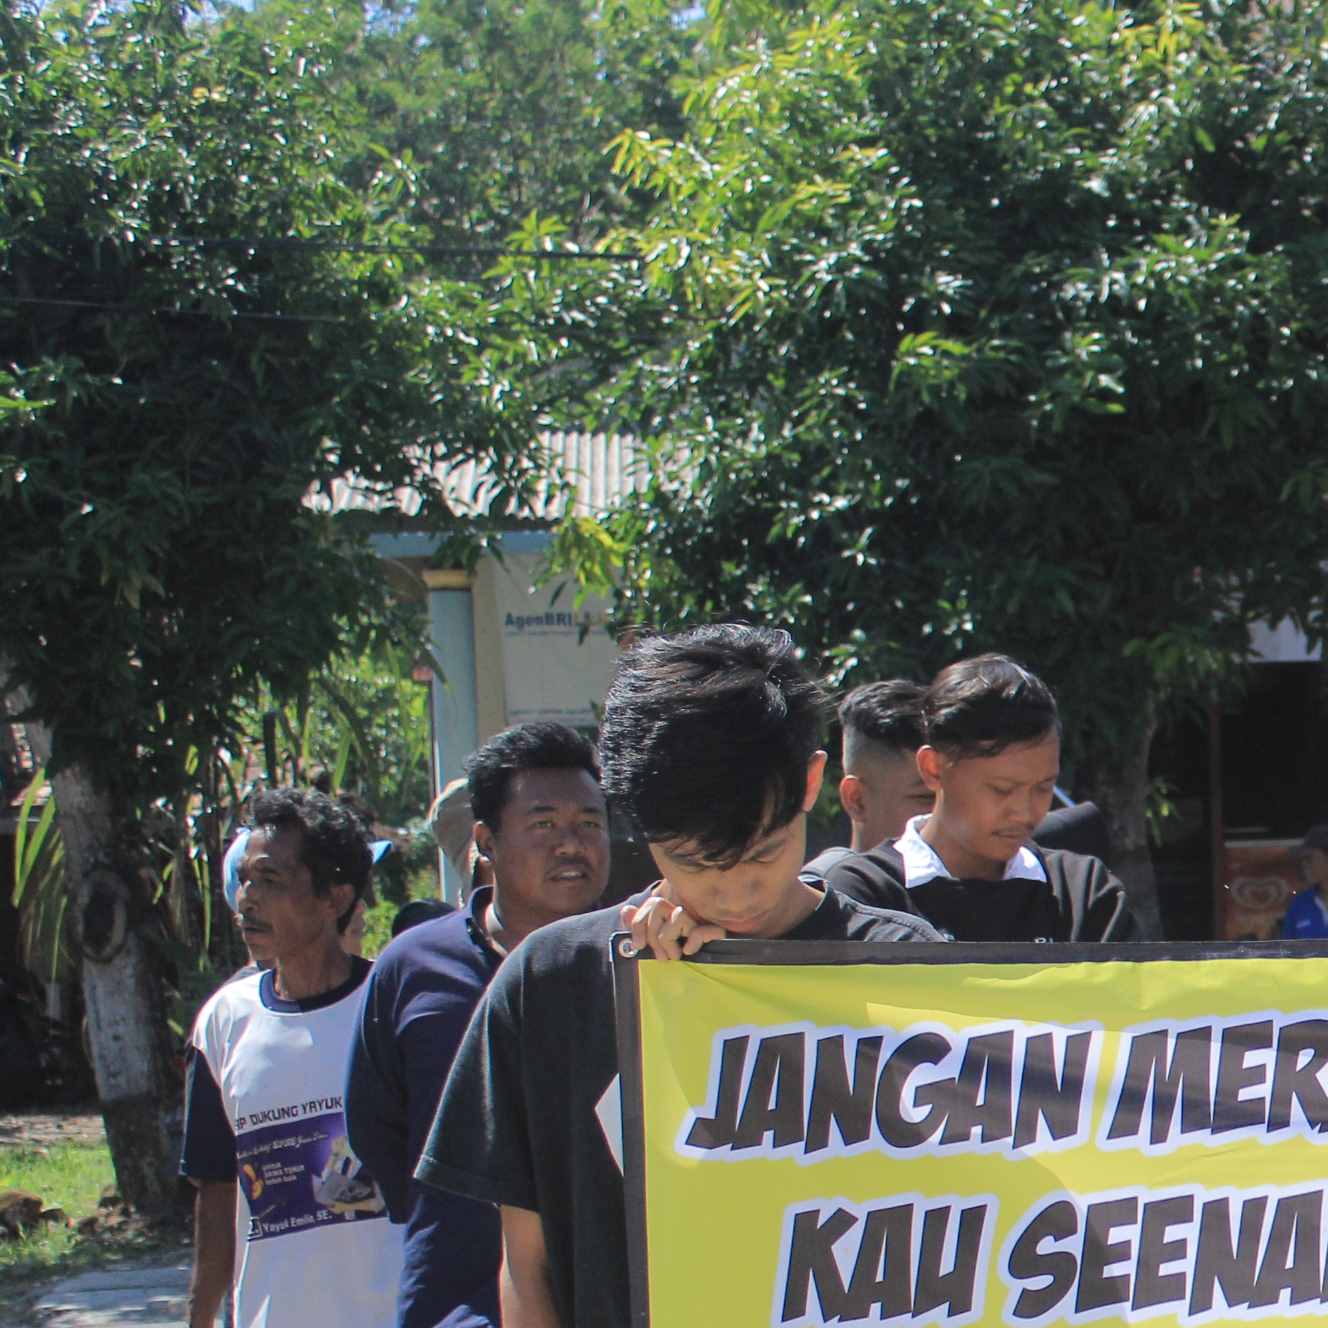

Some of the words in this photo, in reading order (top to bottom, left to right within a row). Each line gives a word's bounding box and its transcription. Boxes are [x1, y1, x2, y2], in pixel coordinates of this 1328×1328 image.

[249, 1105, 299, 1125] DUKUNG
[301, 1096, 343, 1115] YAYUK
[686, 1031, 1088, 1154] JANGAN
[782, 1202, 985, 1323] KAU
